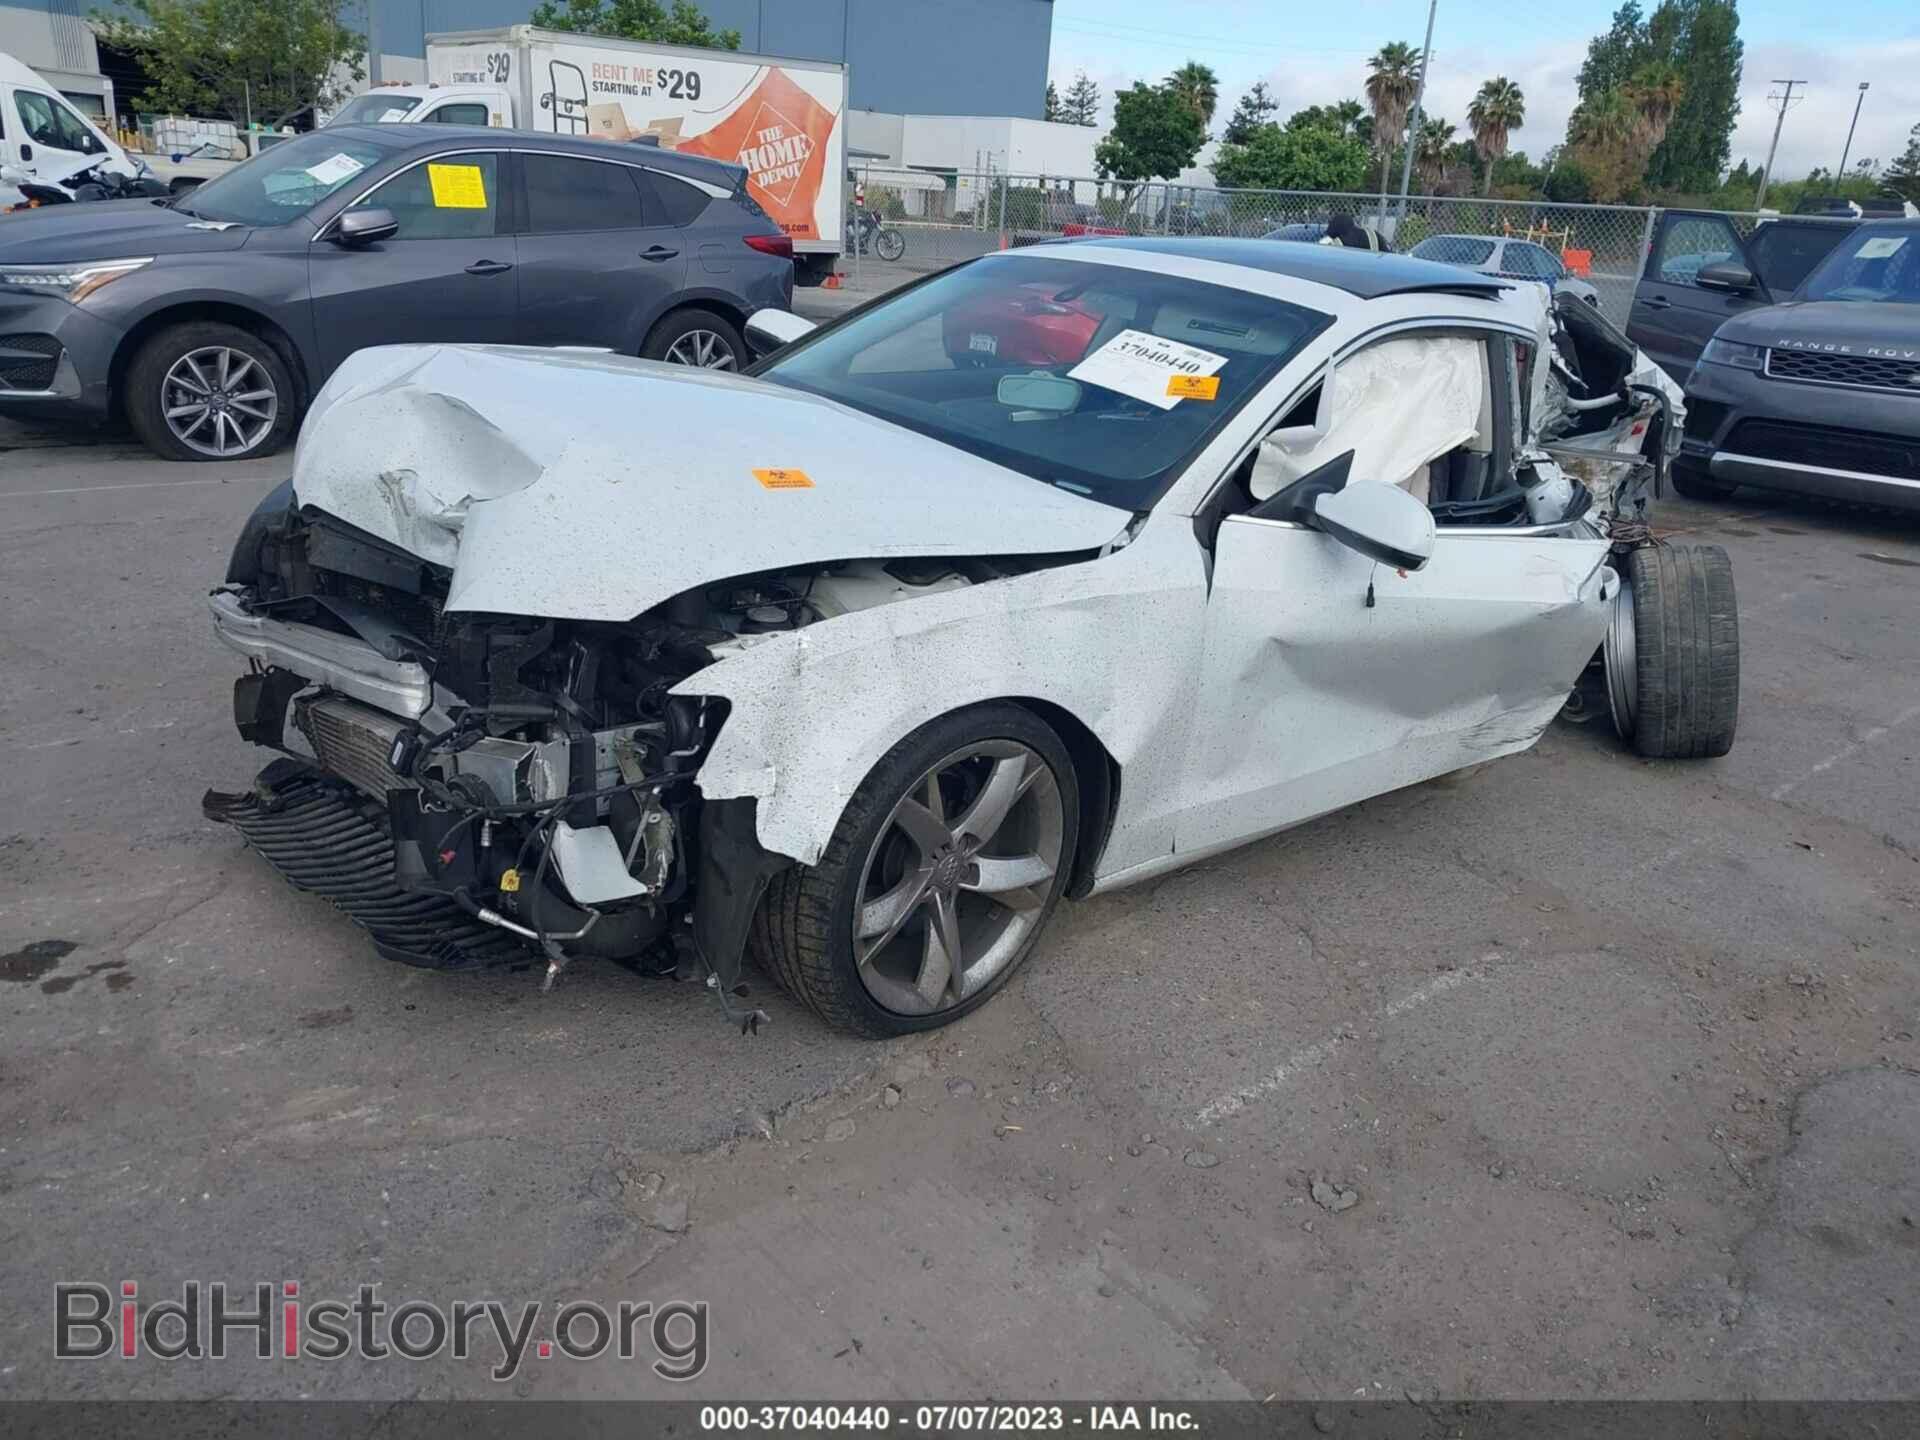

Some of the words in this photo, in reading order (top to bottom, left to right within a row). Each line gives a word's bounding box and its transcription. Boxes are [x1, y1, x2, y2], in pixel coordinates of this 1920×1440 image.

[487, 52, 511, 84] $29
[592, 63, 628, 80] RENT
[633, 67, 654, 84] ME
[592, 81, 639, 96] STARTING
[641, 86, 652, 97] AT
[657, 68, 701, 101] $29
[757, 125, 784, 144] THE
[740, 133, 810, 174] HOME
[758, 161, 801, 187] DEPOT
[1114, 341, 1201, 374] 37040440
[1779, 339, 1851, 353] RANGE
